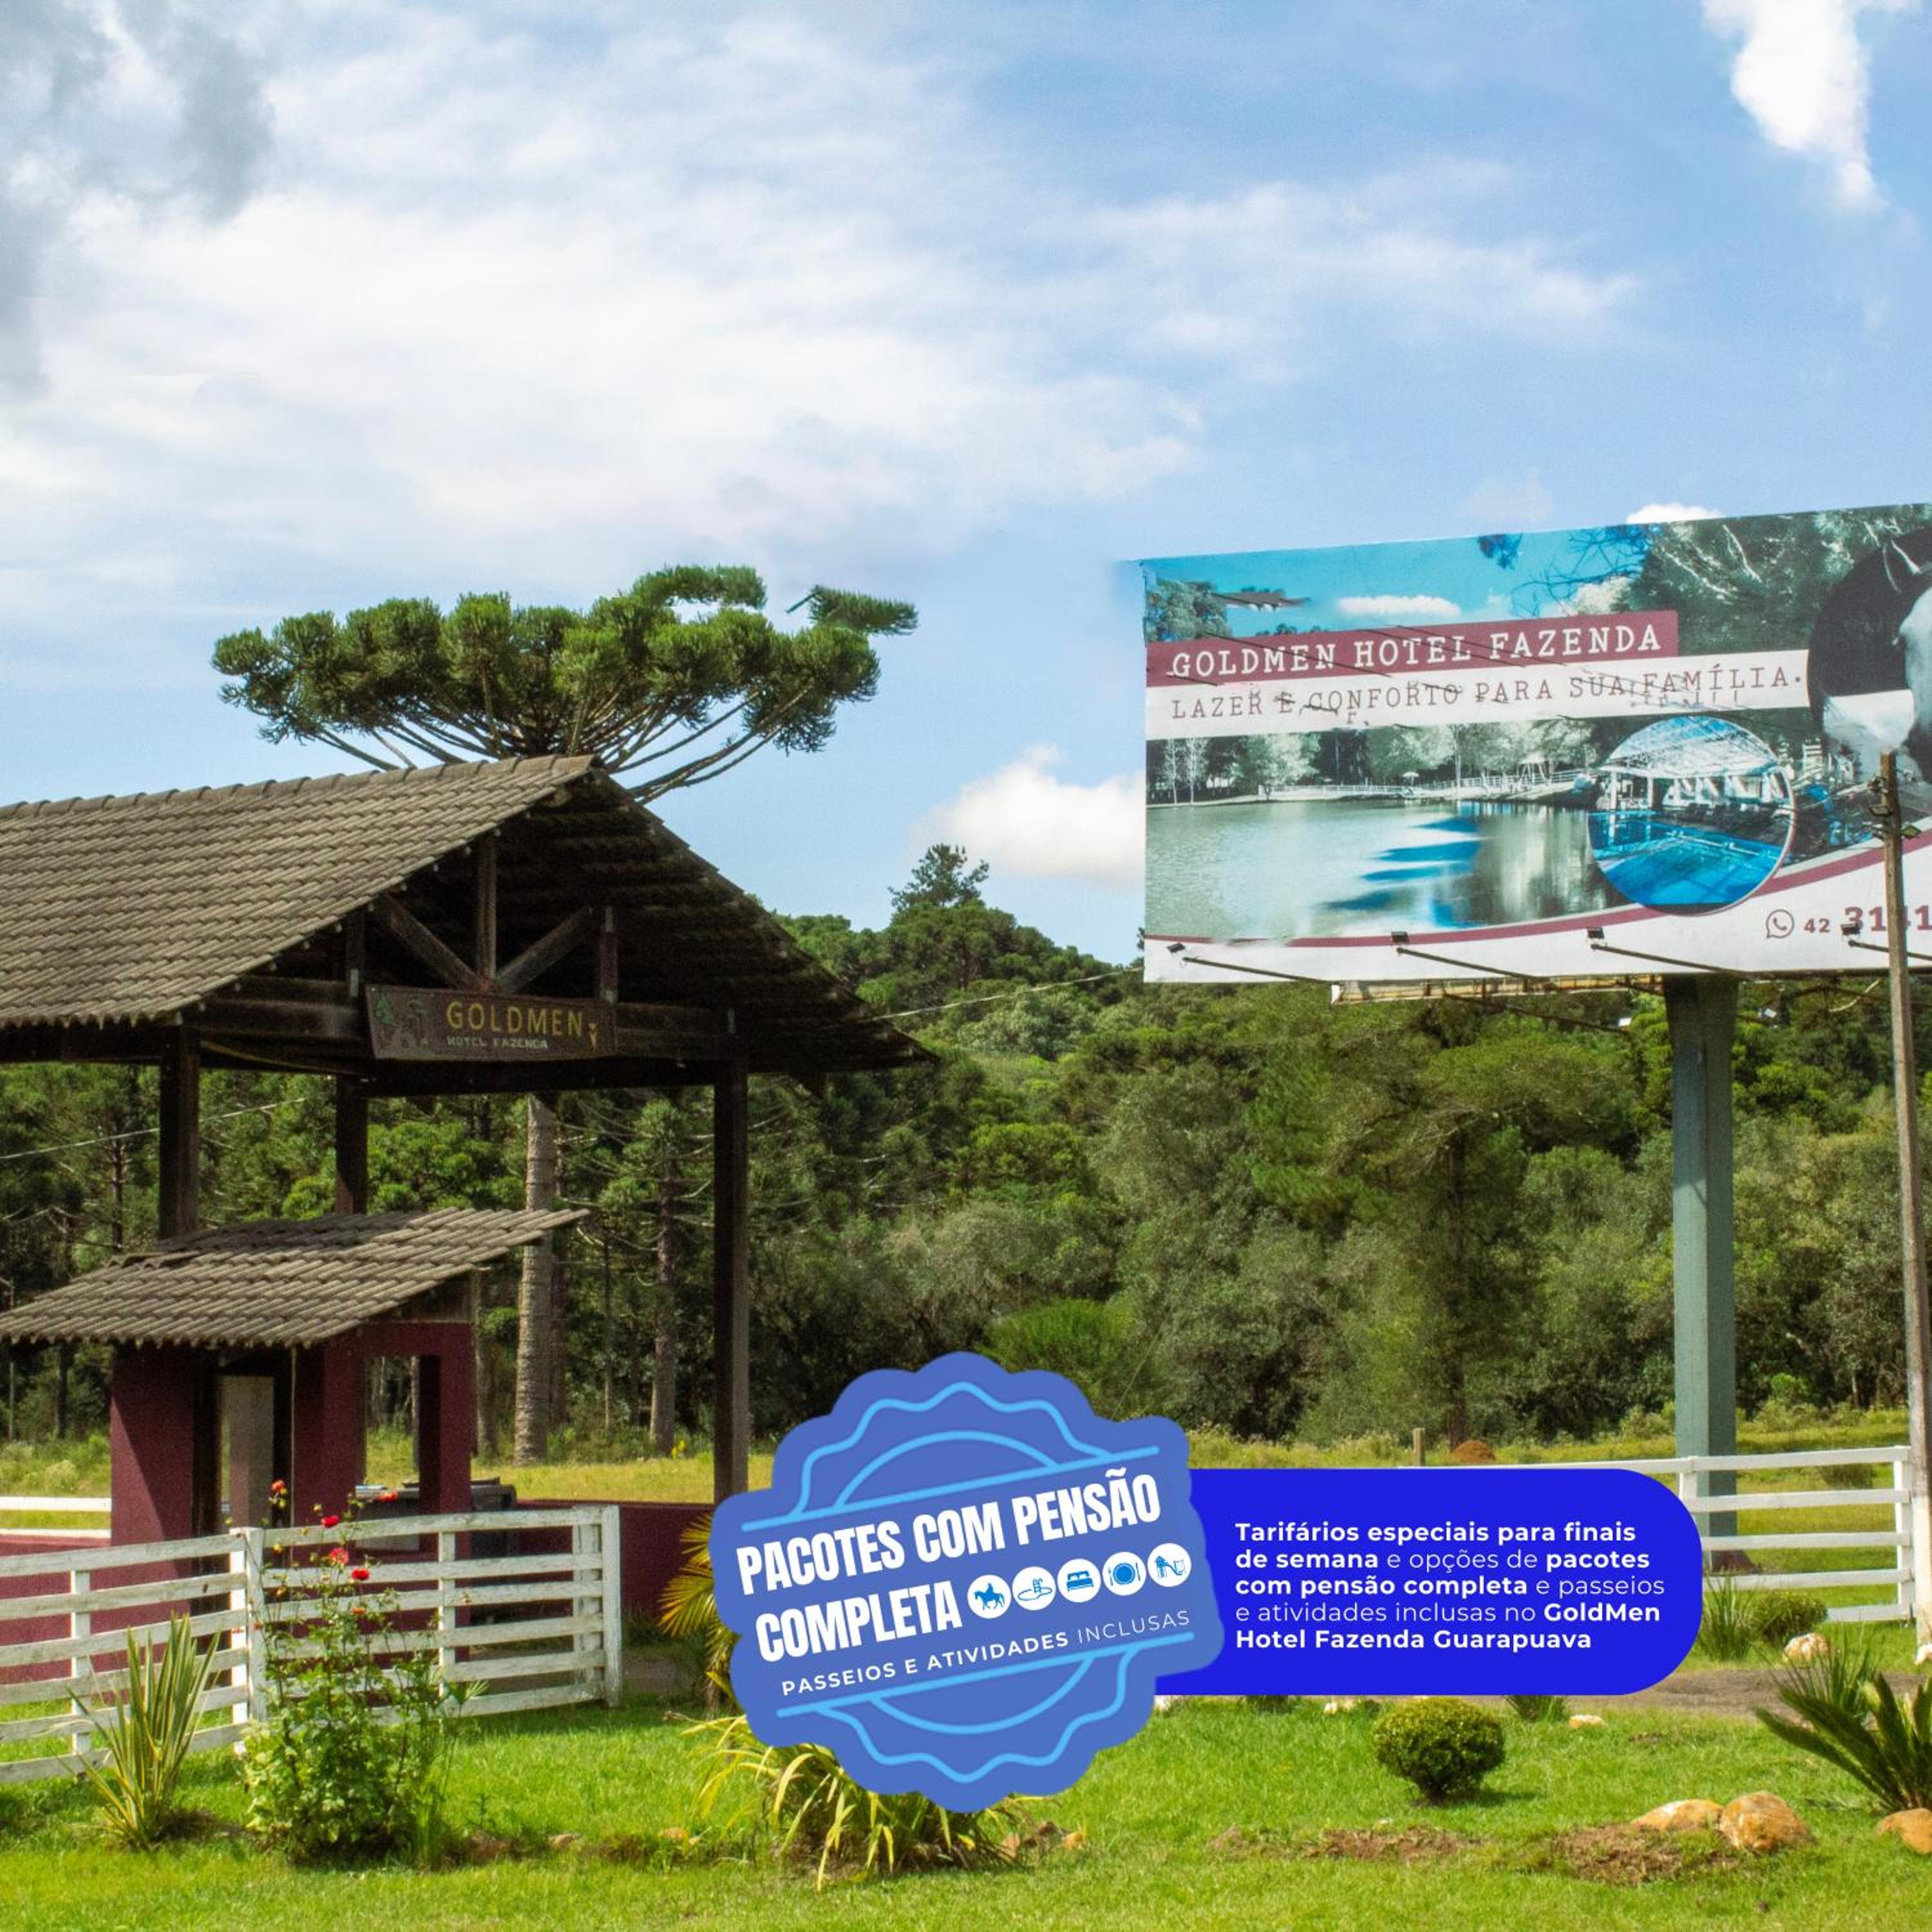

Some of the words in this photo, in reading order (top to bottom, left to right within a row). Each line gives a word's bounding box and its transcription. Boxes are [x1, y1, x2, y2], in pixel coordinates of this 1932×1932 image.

[1171, 643, 1336, 677] GOLDMEN
[1354, 634, 1472, 668] HOTEL
[1490, 624, 1662, 659] FAZENDA
[1171, 694, 1263, 719] LAZER
[1278, 692, 1293, 713] E
[1307, 683, 1461, 711] CONFORTO
[1476, 679, 1553, 703] PARA
[1569, 676, 1625, 697] SUA
[1804, 918, 1830, 933] 42
[446, 1000, 582, 1037] GOLDMEN
[447, 1036, 488, 1047] HOTEL
